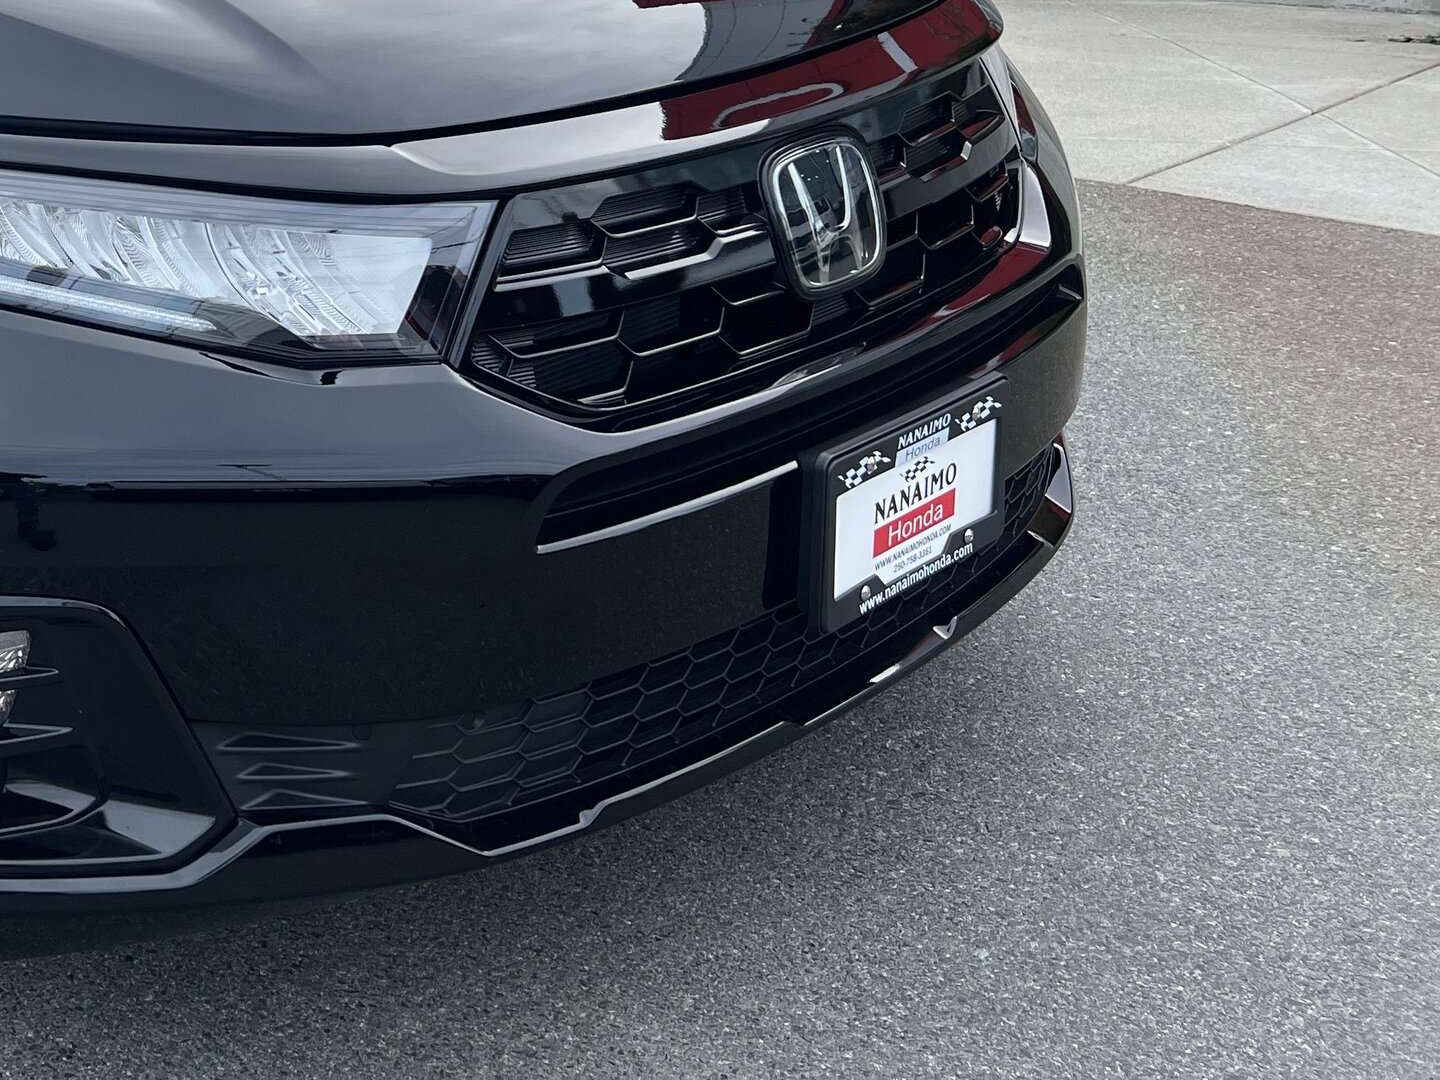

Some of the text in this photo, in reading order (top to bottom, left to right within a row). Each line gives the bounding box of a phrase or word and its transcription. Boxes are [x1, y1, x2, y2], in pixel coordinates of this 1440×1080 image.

[897, 413, 951, 450] NANAIMO
[905, 436, 941, 461] Honda
[874, 462, 957, 525] NANAIMO
[888, 503, 944, 547] Honda
[858, 542, 974, 615] www.nanaimohonda.com
